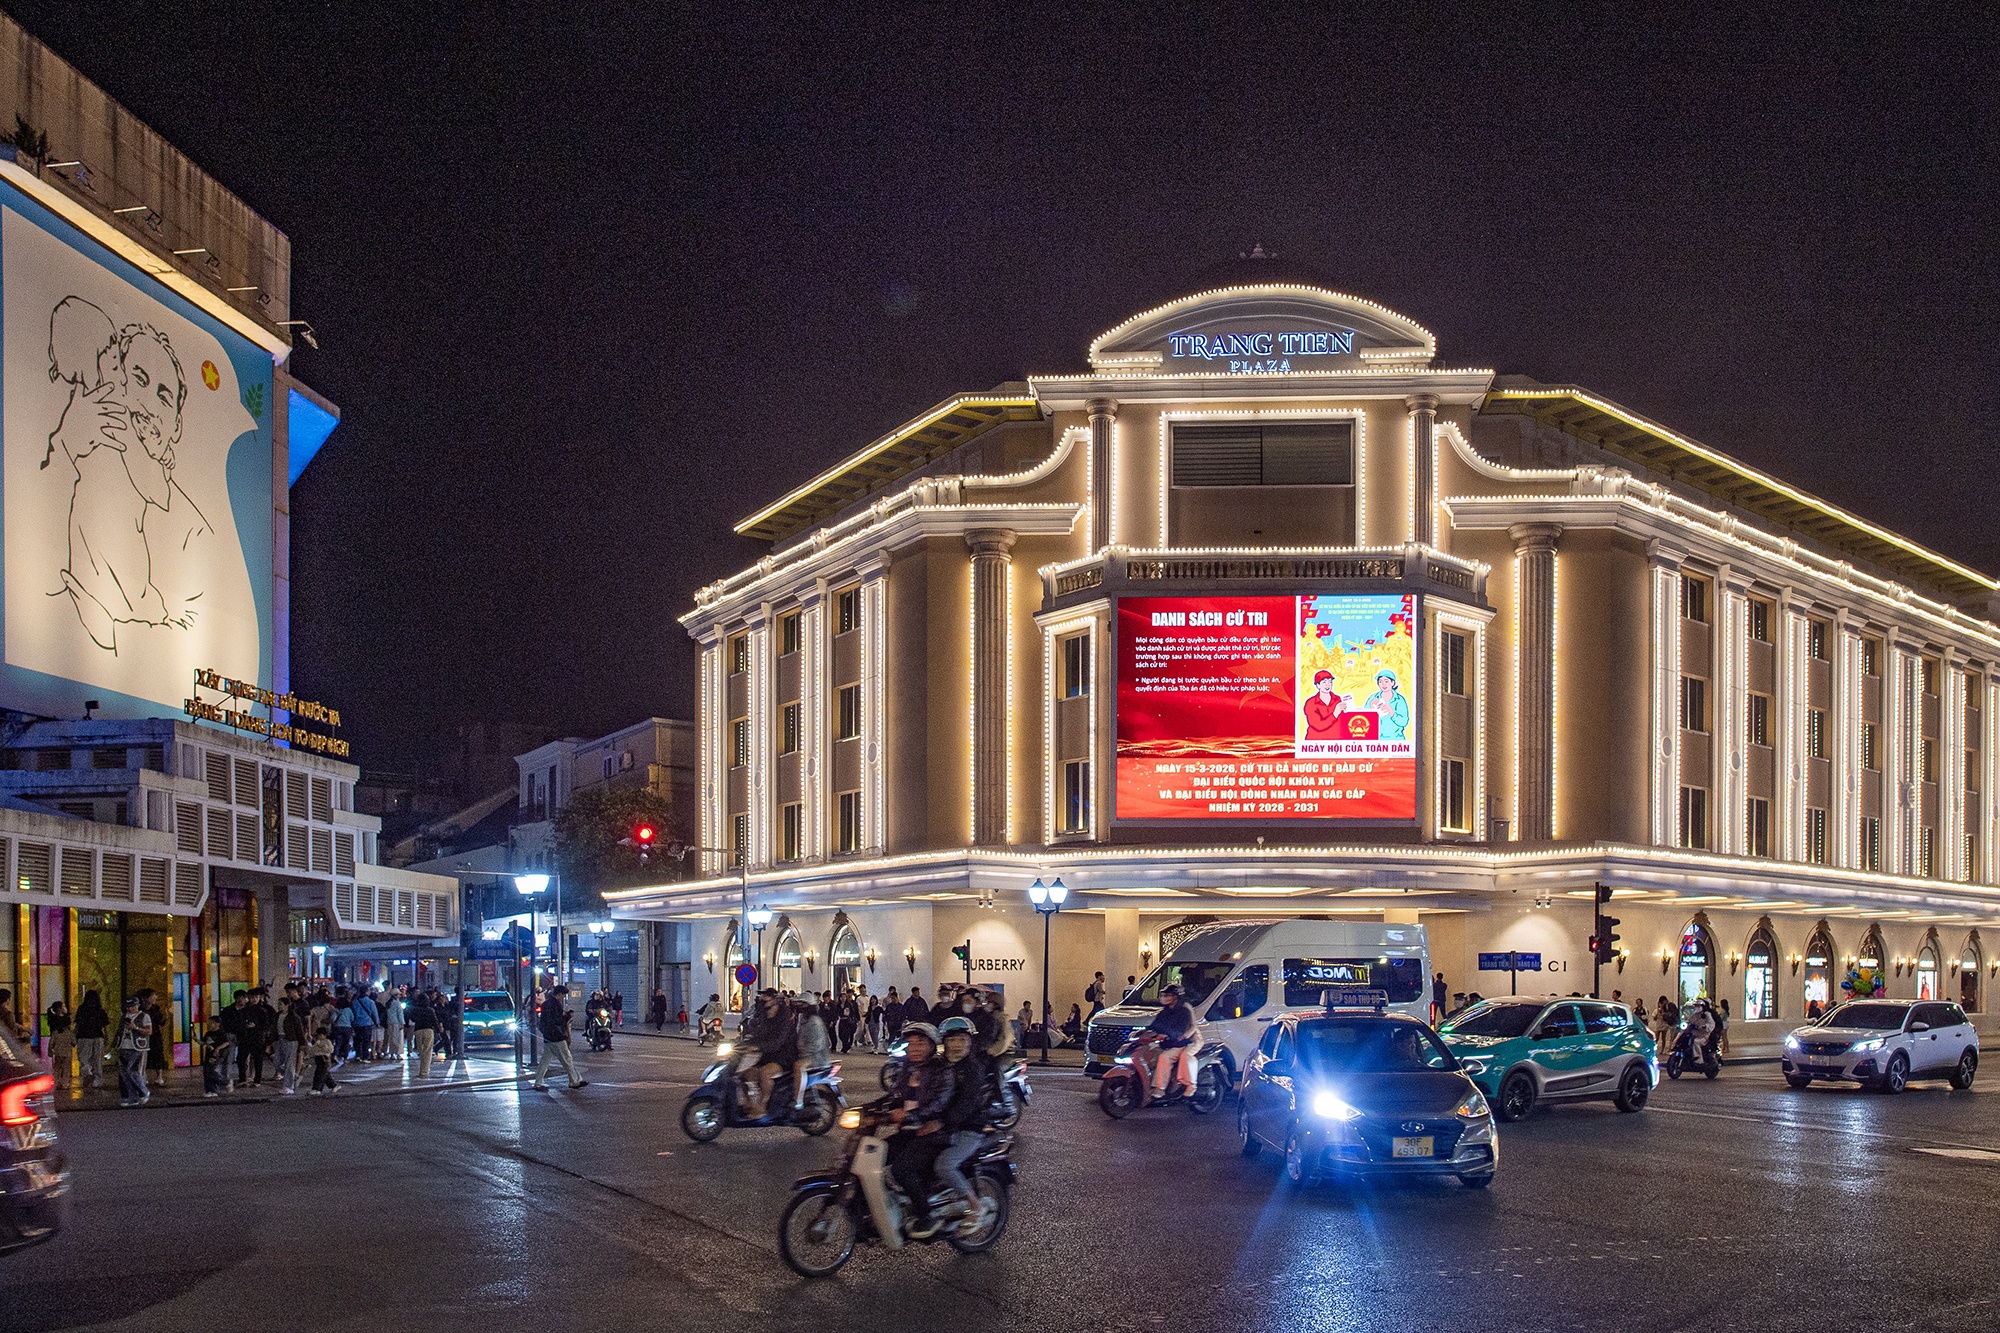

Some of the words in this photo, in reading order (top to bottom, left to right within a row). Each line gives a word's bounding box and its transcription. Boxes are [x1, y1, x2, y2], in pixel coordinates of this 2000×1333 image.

[1168, 333, 1274, 360] TRANG
[1278, 331, 1355, 355] TIEN
[1229, 359, 1292, 372] PLAZA
[1152, 612, 1186, 626] DANH
[1188, 610, 1223, 626] SÁCH
[1226, 608, 1245, 626] CỬ
[1246, 612, 1268, 626] TRI
[1149, 636, 1164, 644] công
[1301, 743, 1325, 752] NGÀY
[1328, 743, 1343, 754] HỘI
[1345, 742, 1363, 752] CỦA
[1366, 743, 1389, 752] TOÀN
[1392, 743, 1410, 752] DÂN
[1155, 763, 1182, 773] NGÀY
[1240, 762, 1255, 773] CỬ
[1257, 764, 1273, 773] TRI
[1292, 762, 1319, 773] NƯỚC
[1322, 764, 1333, 773] ĐI
[1336, 761, 1356, 773] BẦU
[1359, 762, 1374, 773] CỬ
[1193, 777, 1211, 787] ĐẠI
[1213, 774, 1236, 786] BIỂU
[1239, 775, 1266, 787] QUỐC
[1268, 776, 1286, 787] HỘI
[1289, 775, 1316, 786] KHÓA
[1318, 777, 1335, 786] XVI
[1159, 789, 1173, 799] VÀ
[1175, 790, 1193, 801] ĐẠI
[1195, 788, 1218, 799] BIỂU
[1220, 789, 1238, 801] HỘI
[1240, 788, 1268, 799] ĐỒNG
[1270, 789, 1297, 799] NHÂN
[1300, 789, 1320, 799] DÂN
[1323, 789, 1343, 799] CÁC
[1346, 787, 1366, 799] CẤP
[1209, 802, 1240, 813] NHIỆM
[1243, 802, 1256, 812] KỲ
[1258, 803, 1285, 812] 2026
[1294, 803, 1319, 812] 2031
[962, 959, 1026, 971] BURBERRY
